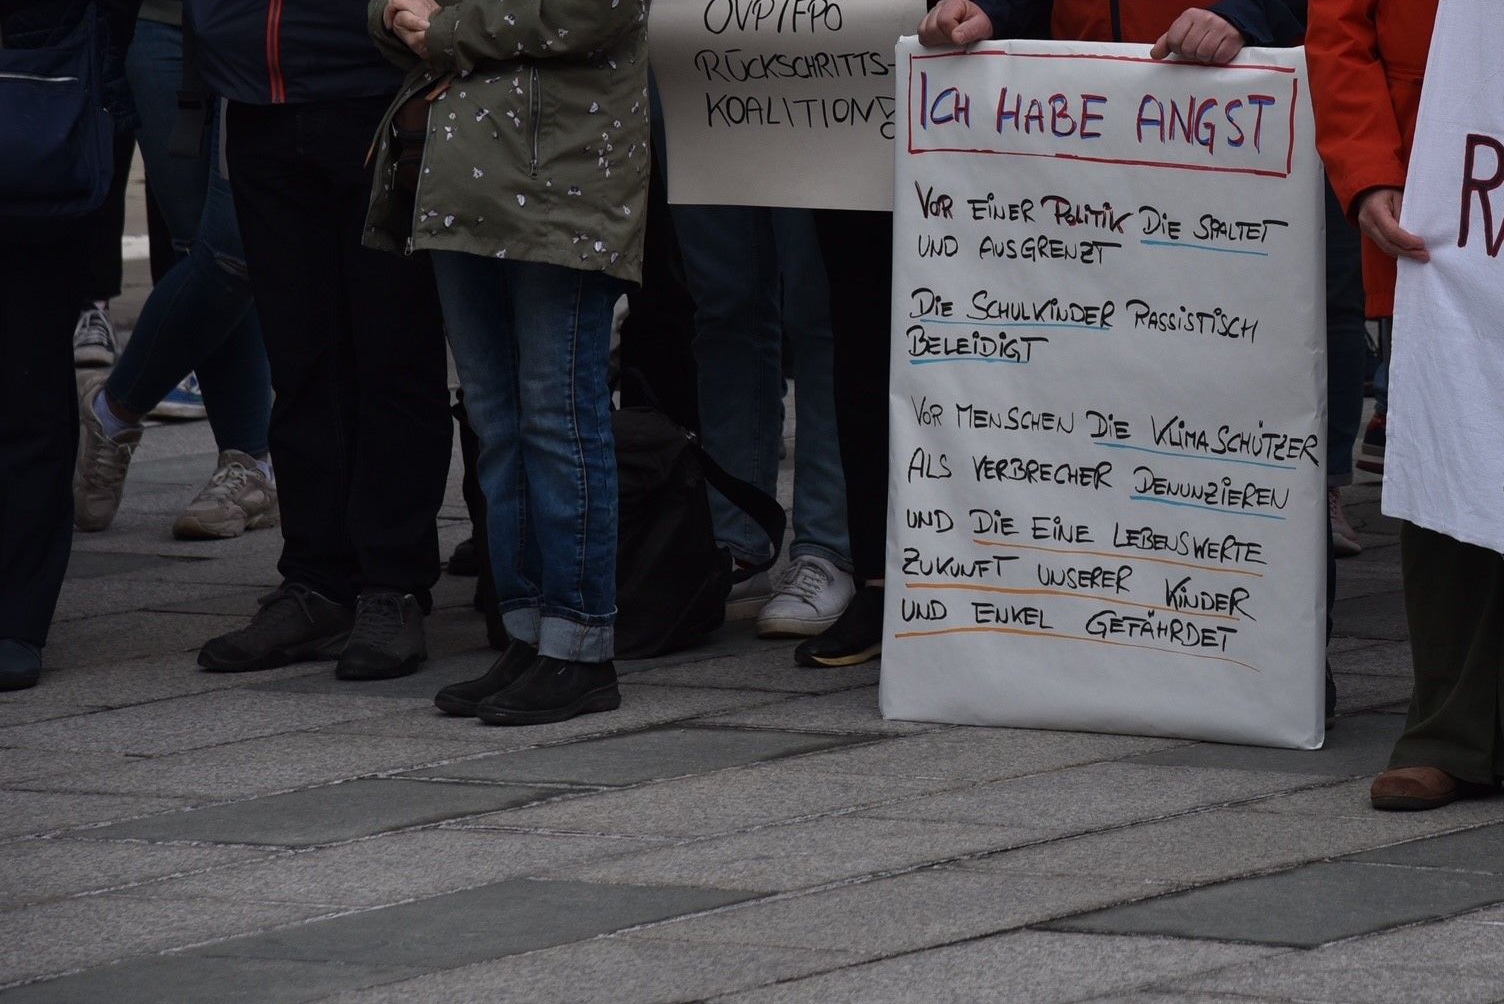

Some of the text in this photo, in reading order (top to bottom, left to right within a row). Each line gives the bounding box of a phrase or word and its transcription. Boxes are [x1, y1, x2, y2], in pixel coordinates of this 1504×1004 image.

[921, 71, 1275, 154] ICH HABE ANGST
[918, 235, 1121, 264] UND AUSGRENZT
[1193, 214, 1289, 243] SPALTET
[956, 403, 1074, 434] MENSCHEN
[908, 448, 952, 482] ALS
[973, 456, 1113, 489] VERBRECHER
[906, 509, 953, 532] UND
[1114, 522, 1267, 564] LEBENSWERTE
[902, 548, 1020, 579] ZUKUNFT
[1037, 563, 1132, 593] UNSERER
[902, 600, 1237, 651] UND ENKEL GEFÄHRDET
